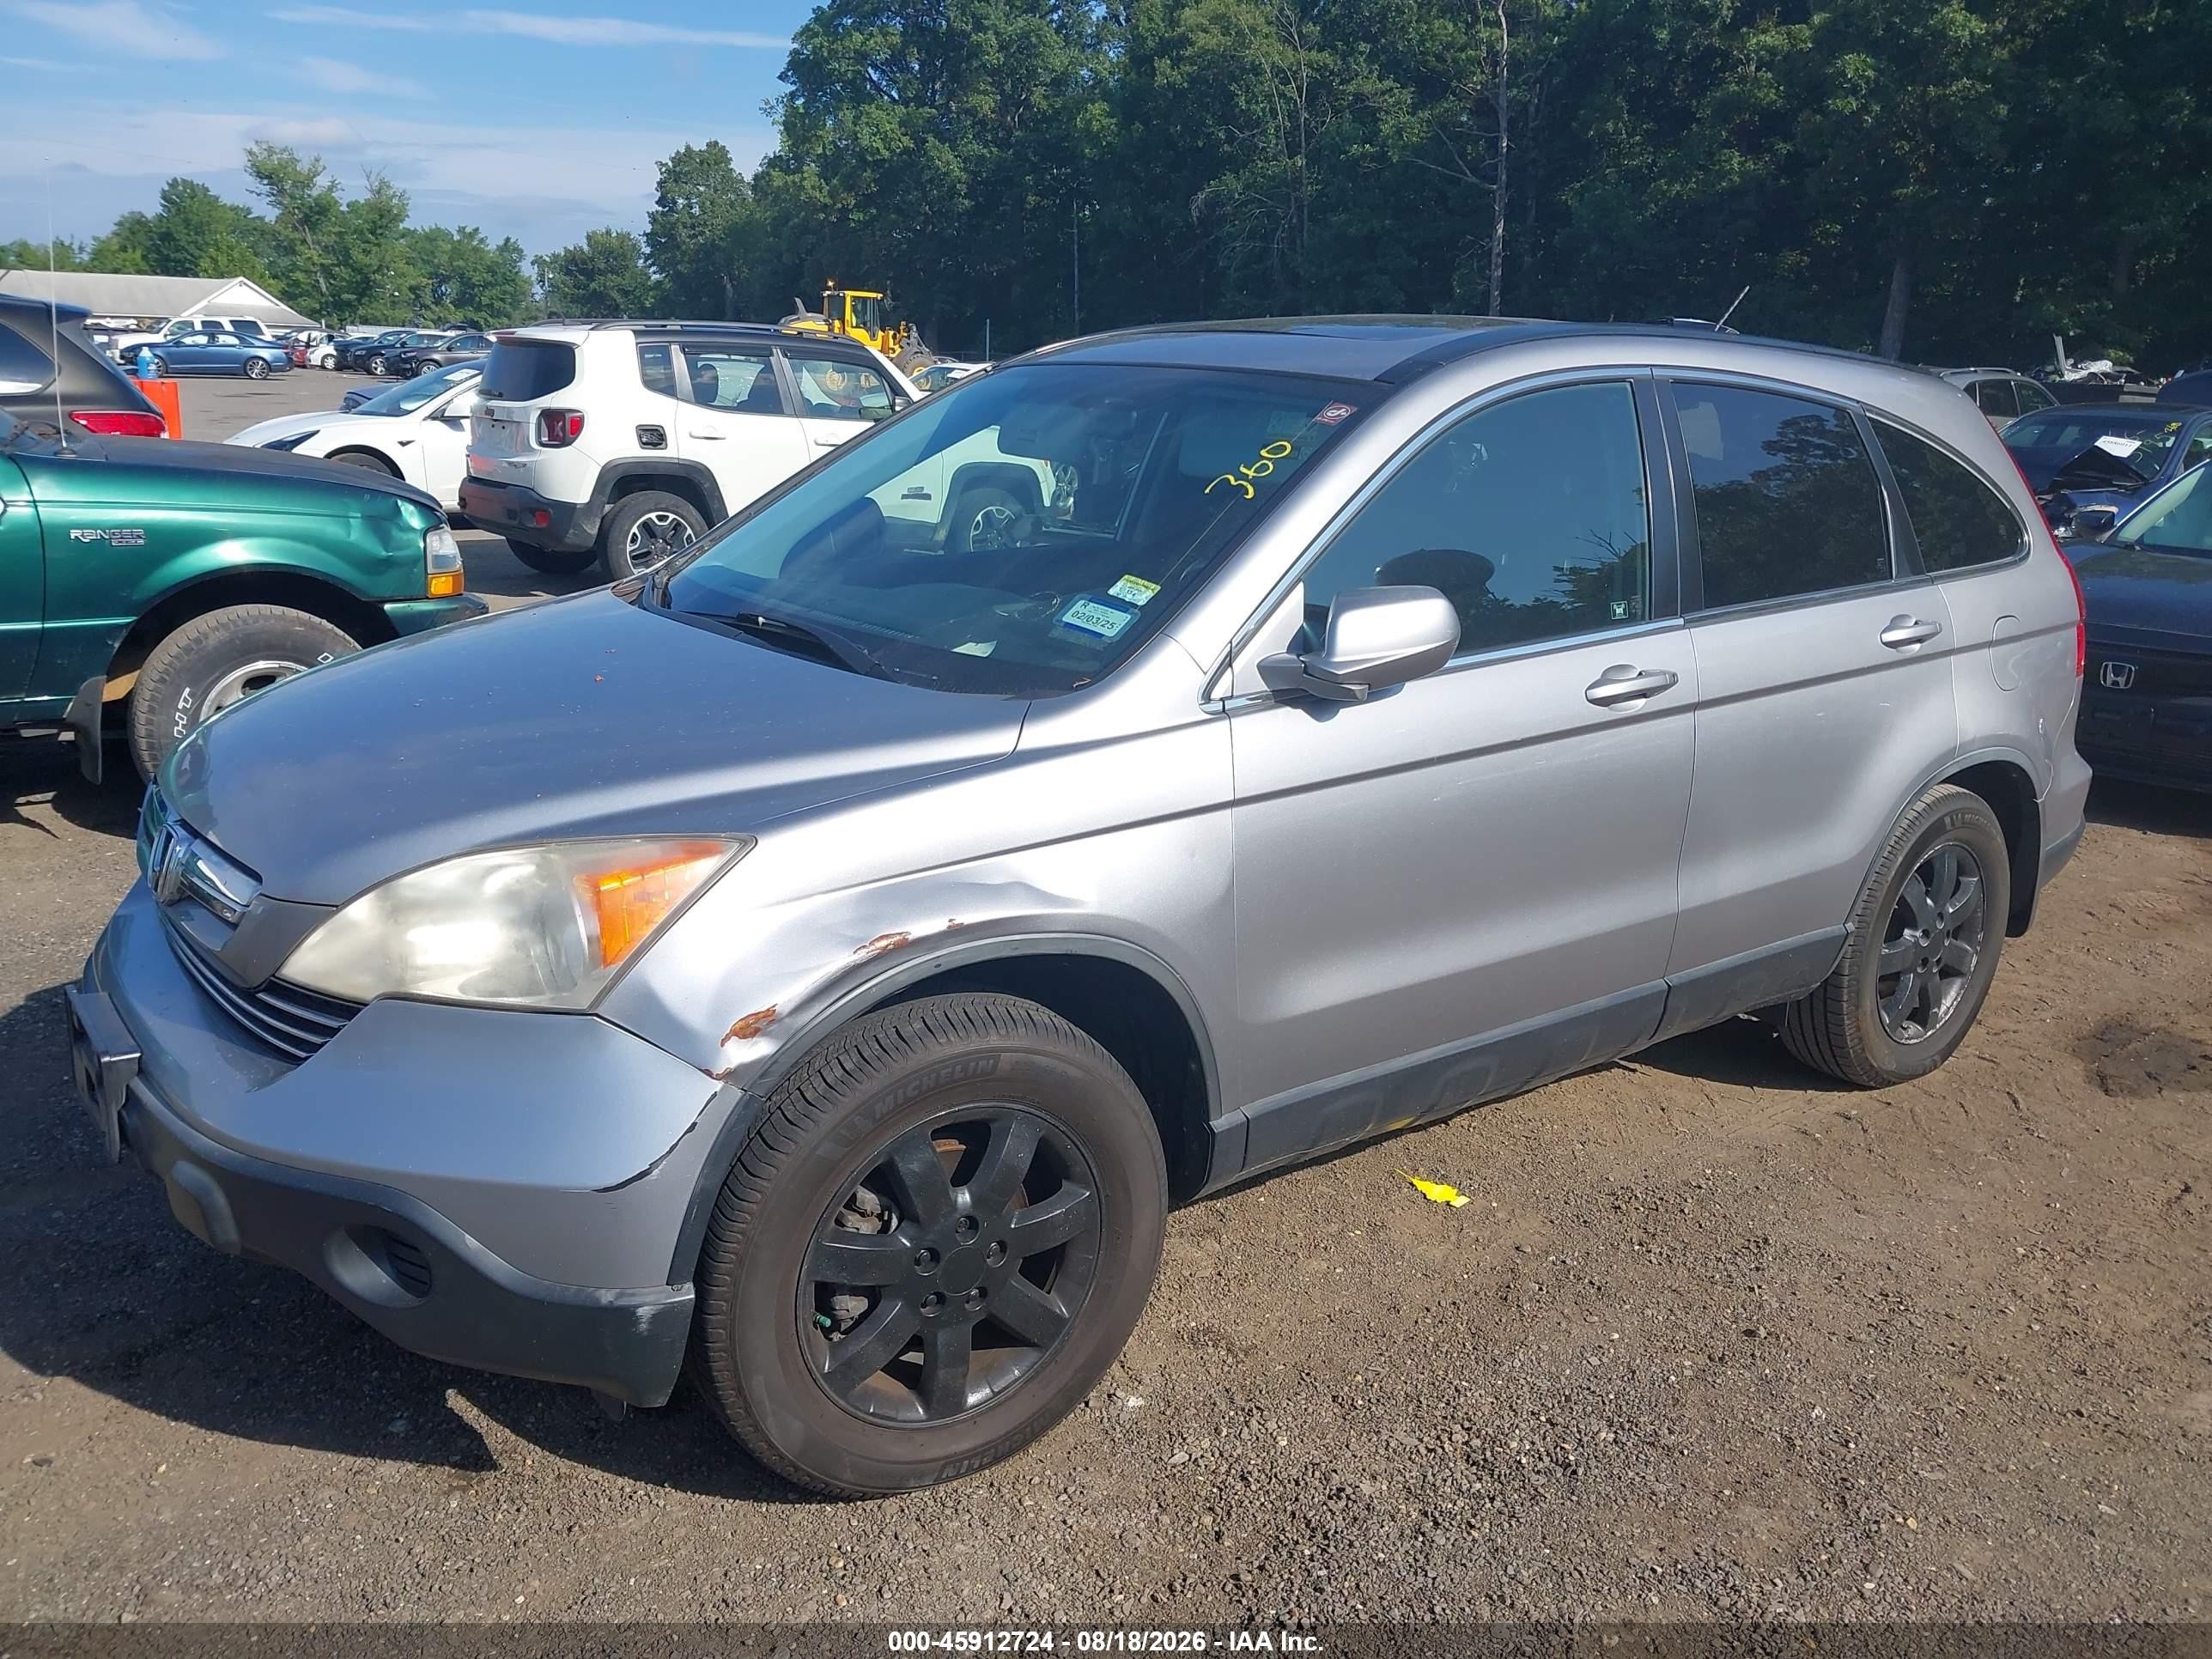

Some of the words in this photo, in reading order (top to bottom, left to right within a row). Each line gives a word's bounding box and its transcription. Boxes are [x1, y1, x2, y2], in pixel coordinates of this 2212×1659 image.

[1204, 441, 1291, 499] 360
[70, 529, 145, 543] RANGER
[1079, 601, 1091, 610] R
[1071, 611, 1117, 630] 02/03/25
[874, 1058, 994, 1117] MICHELIN
